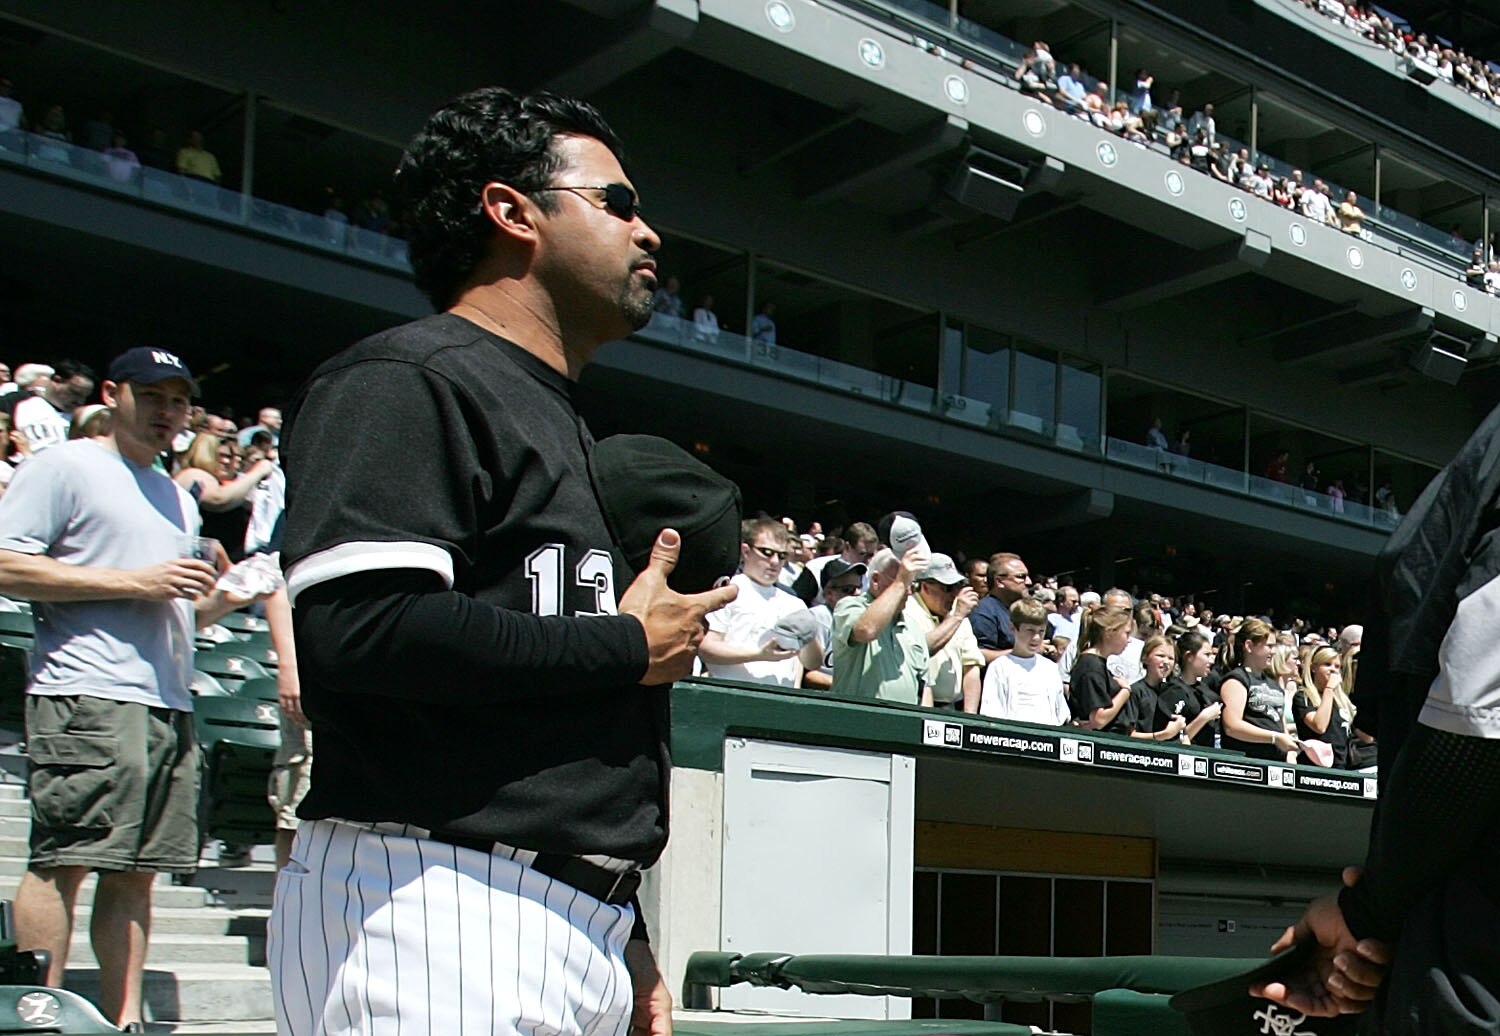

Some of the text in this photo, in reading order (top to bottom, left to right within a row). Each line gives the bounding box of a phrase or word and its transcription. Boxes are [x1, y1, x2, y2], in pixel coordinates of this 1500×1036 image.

[969, 732, 1054, 753] neweracap.com
[1100, 749, 1173, 769] neweracap.com
[1299, 775, 1360, 791] neweracap.com
